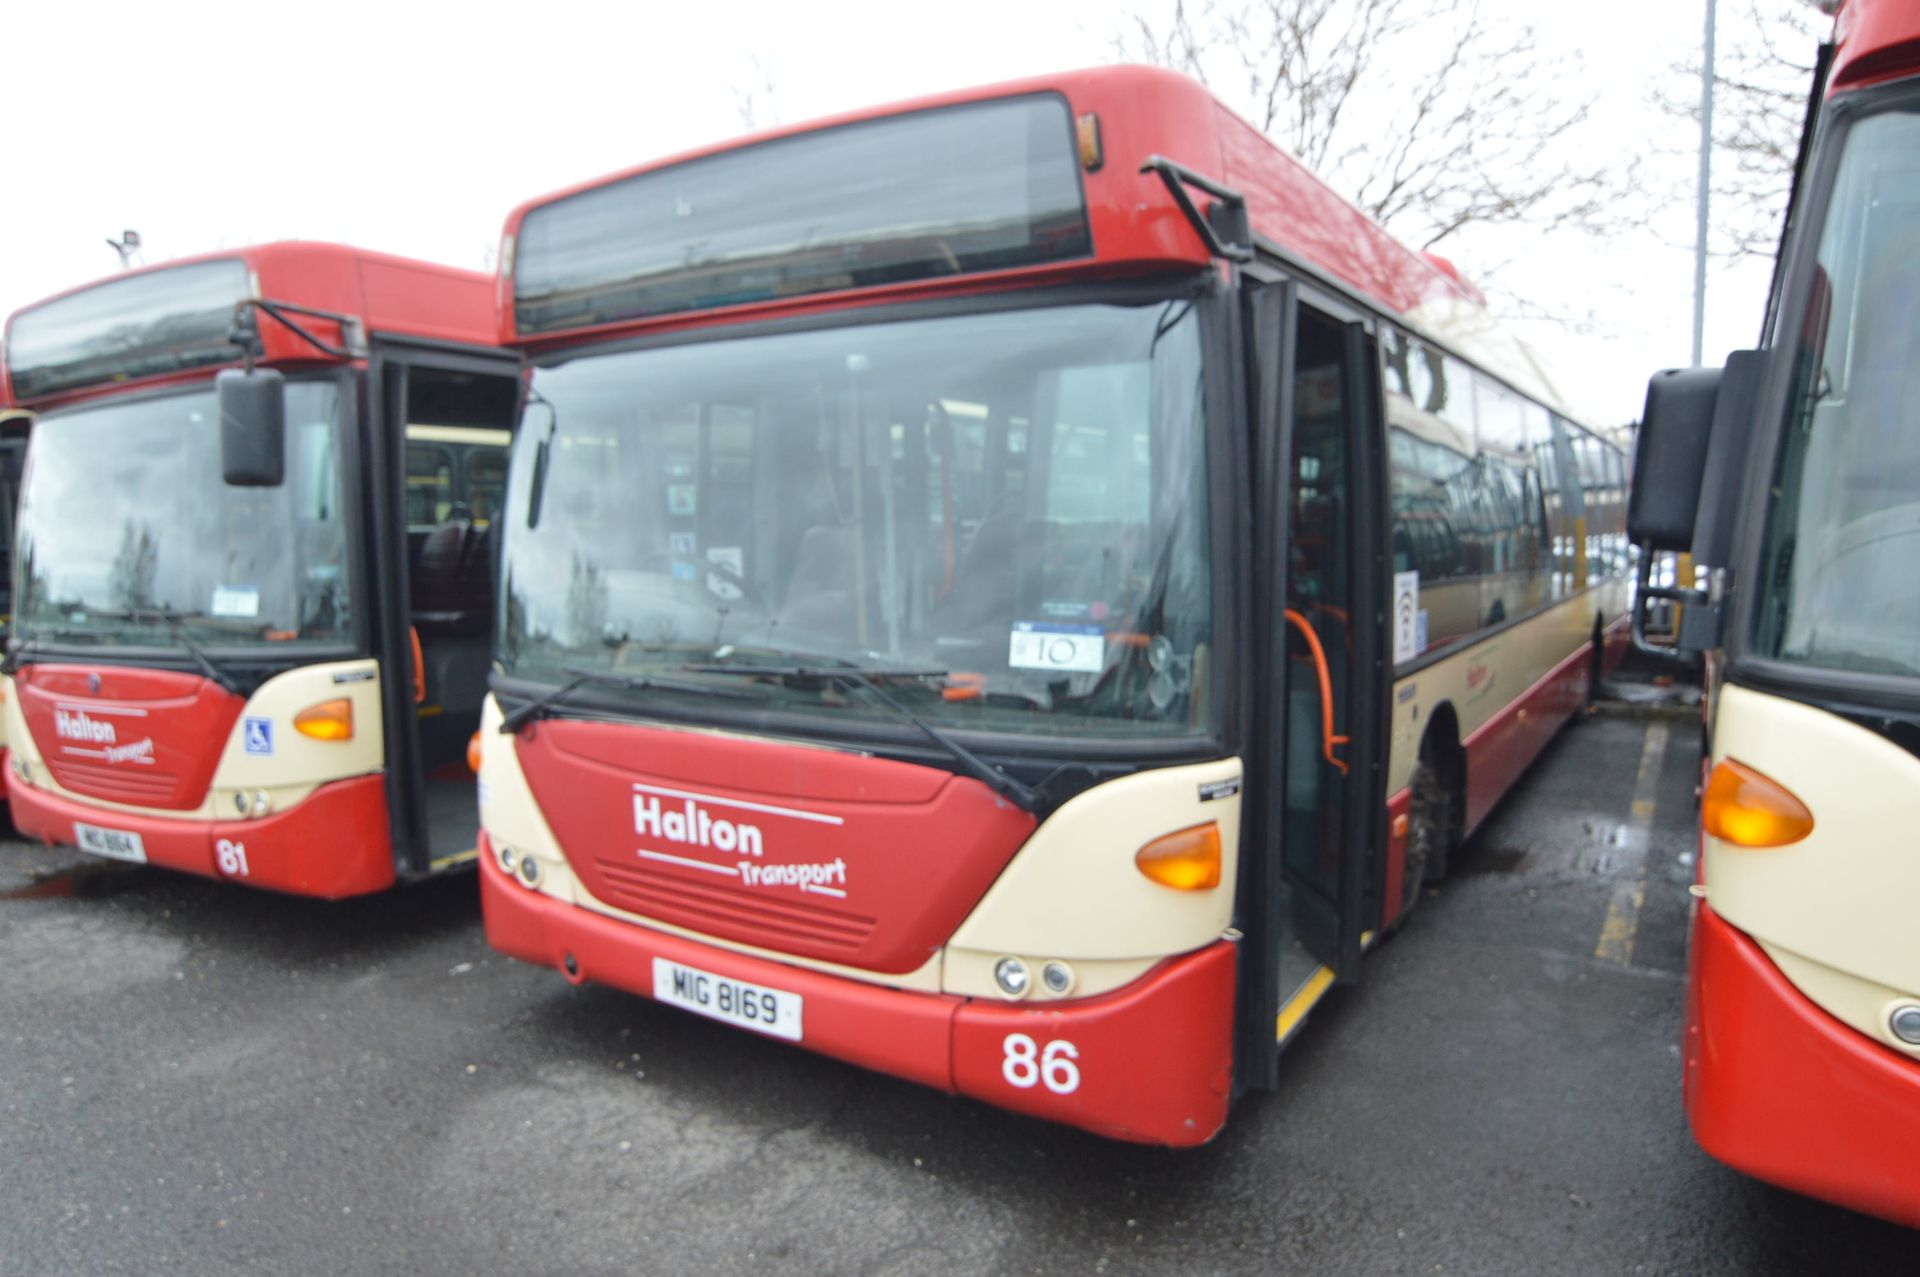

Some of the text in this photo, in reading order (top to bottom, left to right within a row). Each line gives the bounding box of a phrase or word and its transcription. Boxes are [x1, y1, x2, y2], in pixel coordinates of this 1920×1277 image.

[1038, 636, 1076, 664] 10
[55, 709, 117, 744] Halton
[105, 737, 154, 763] Transport
[633, 794, 763, 857] Halton
[216, 839, 249, 876] 81
[737, 857, 847, 892] Transport
[672, 967, 778, 1025] WIG 8169
[1001, 1032, 1081, 1095] 86
